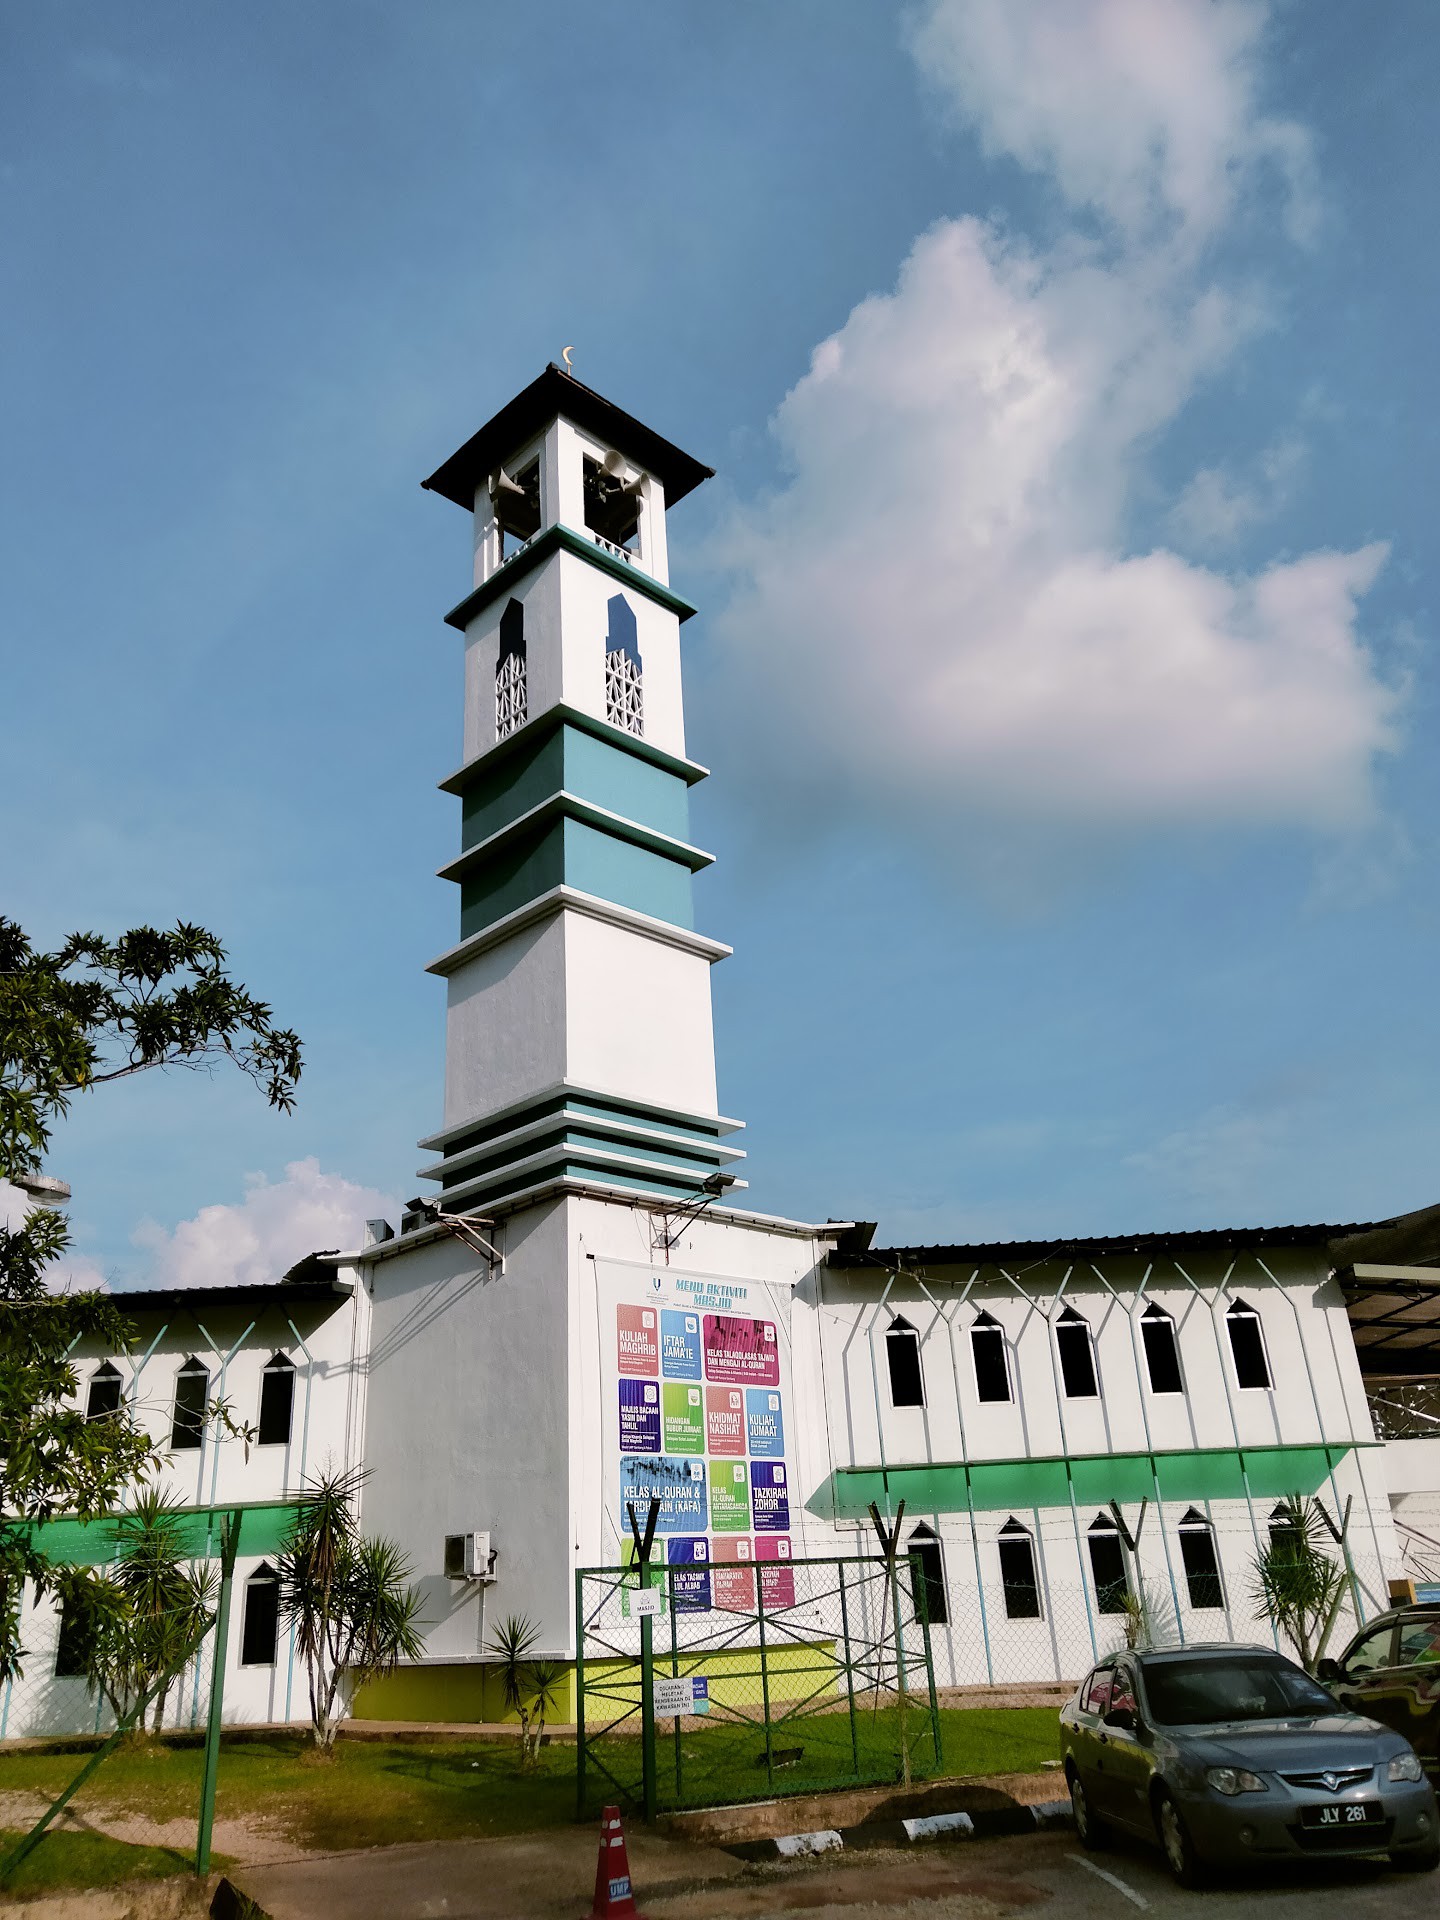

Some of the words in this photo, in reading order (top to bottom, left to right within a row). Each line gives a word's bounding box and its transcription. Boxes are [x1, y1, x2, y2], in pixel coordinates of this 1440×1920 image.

[676, 1279, 704, 1293] MENU
[707, 1284, 747, 1299] AKTIVITI
[694, 1294, 732, 1309] MASJID
[619, 1330, 648, 1343] KULIAH
[663, 1335, 685, 1347] IFTAR
[620, 1342, 656, 1355] MAGHRIB
[664, 1346, 693, 1359] JAMA'IE
[707, 1349, 723, 1357] KELAS
[708, 1358, 718, 1366] DAN
[621, 1405, 639, 1414] MAJLIS
[640, 1407, 658, 1415] BACAAN
[636, 1414, 647, 1422] DAN
[709, 1412, 741, 1423] KHIDMAT
[749, 1414, 774, 1425] KULIAH
[709, 1423, 740, 1435] NASIHAT
[750, 1425, 777, 1437] JUMAAT
[624, 1486, 649, 1498] KELAS
[652, 1486, 692, 1499] AL-QURAN
[694, 1487, 700, 1498] &
[753, 1487, 787, 1499] TAZKIRAH
[675, 1500, 701, 1515] (KAFA)
[754, 1499, 779, 1510] ZOHOR
[1320, 1807, 1340, 1823] JLY
[1345, 1805, 1367, 1822] 261
[610, 1882, 629, 1896] UMP
